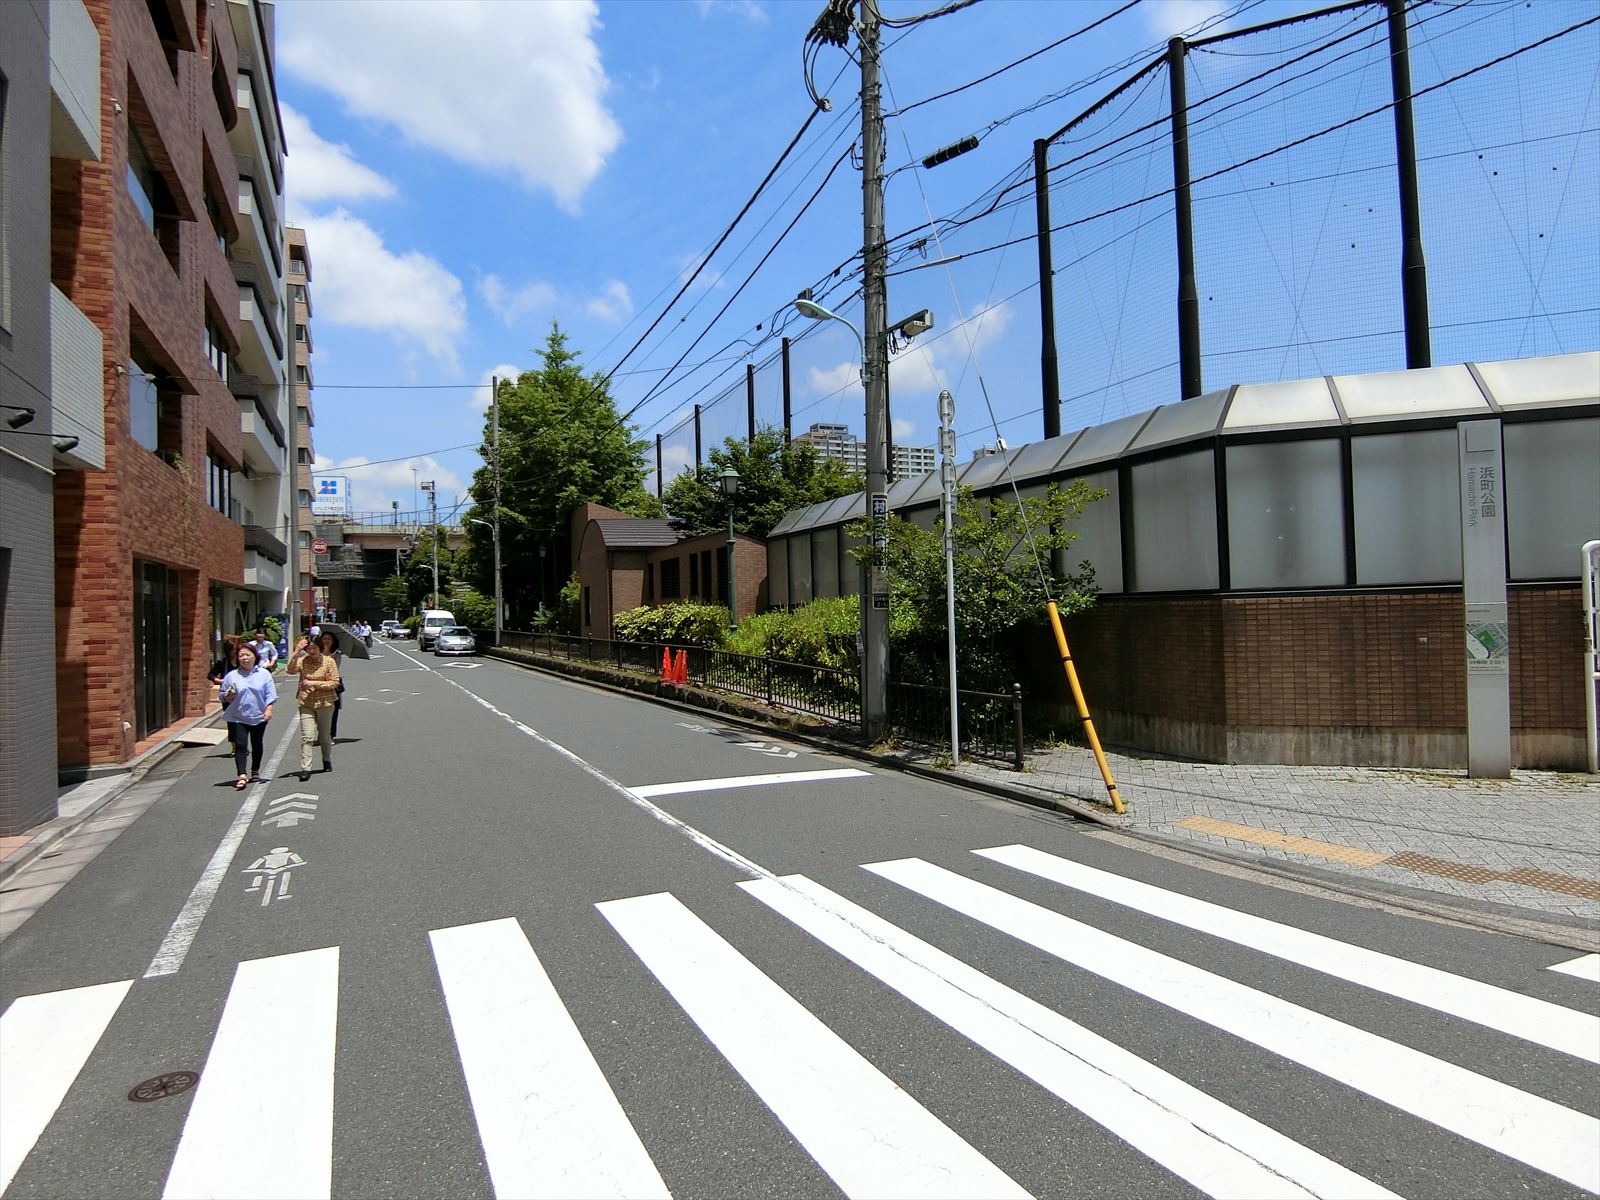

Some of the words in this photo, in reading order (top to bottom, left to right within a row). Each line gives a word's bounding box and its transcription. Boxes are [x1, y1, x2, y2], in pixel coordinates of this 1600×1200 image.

[1467, 467, 1477, 507] Hamacho
[1480, 466, 1496, 518] 浜町公園
[1468, 508, 1478, 528] Park
